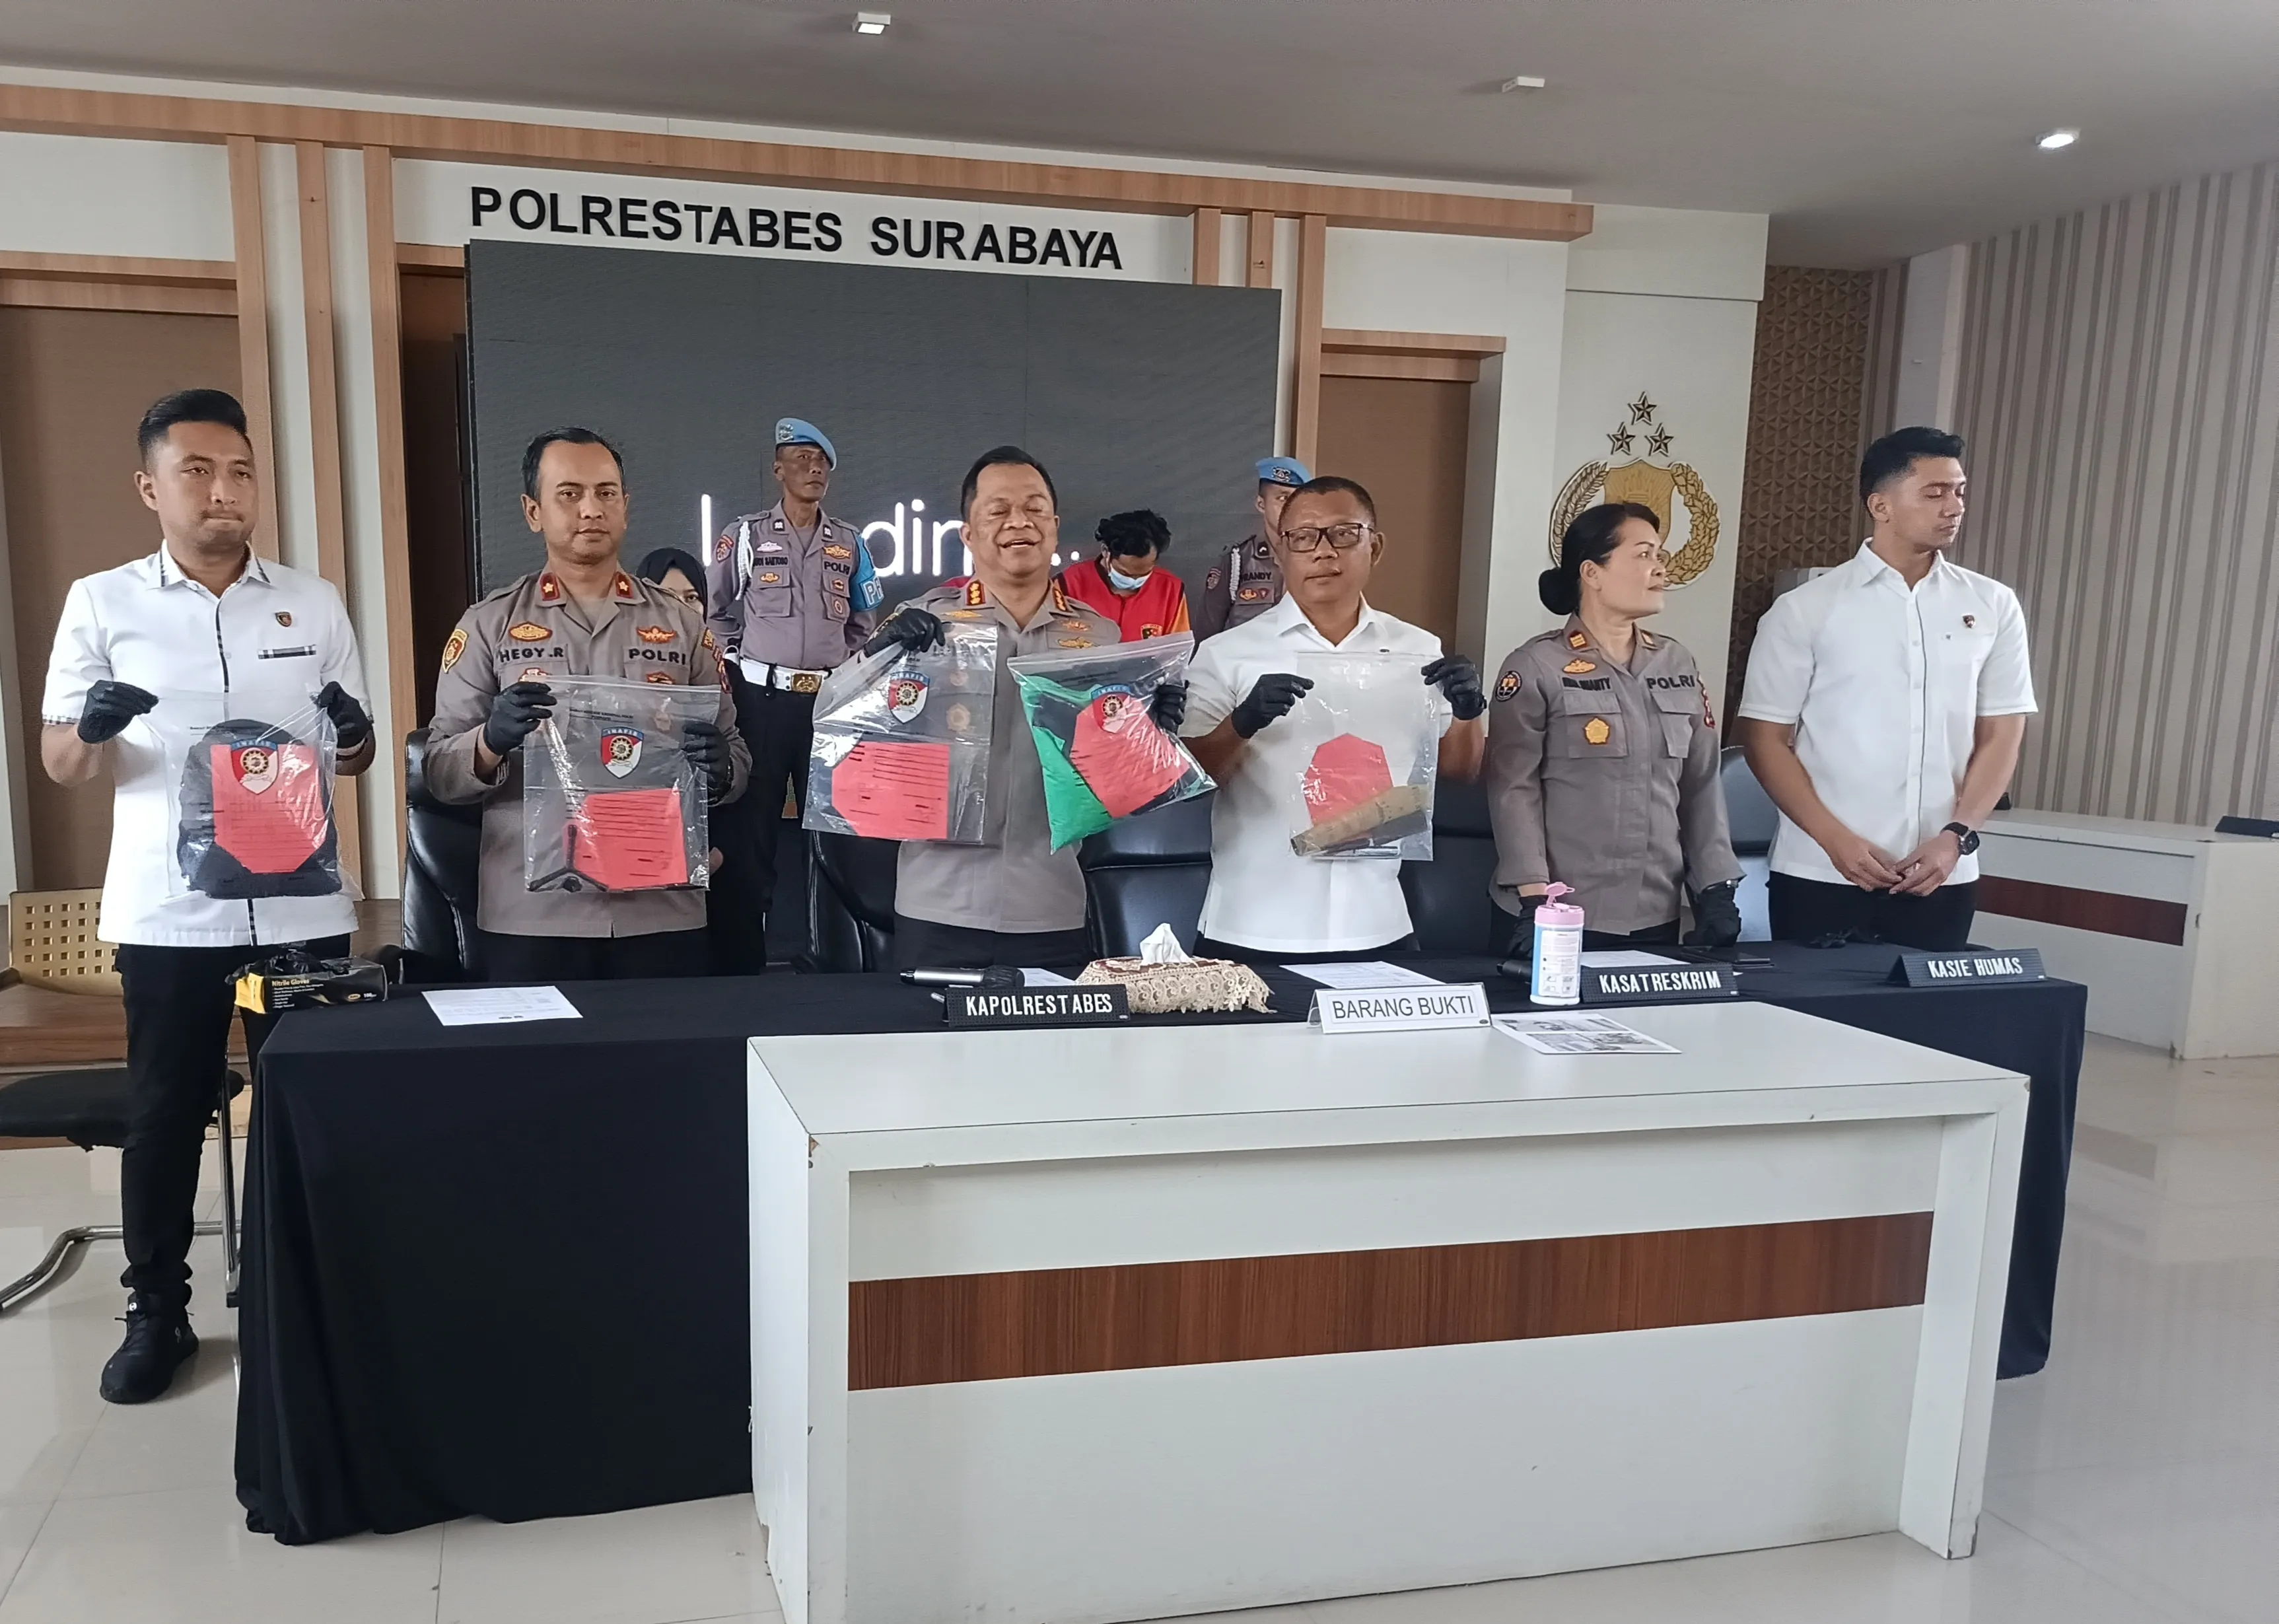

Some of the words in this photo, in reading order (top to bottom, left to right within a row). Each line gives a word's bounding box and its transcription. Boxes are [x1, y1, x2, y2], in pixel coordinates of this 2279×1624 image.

[470, 186, 842, 252] POLRESTABES
[870, 216, 1123, 271] SURABAYA
[824, 561, 850, 575] POLRI
[629, 648, 686, 666] POLRI
[1646, 674, 1695, 689] POLRI
[1928, 959, 1972, 978] KASIE
[1974, 957, 2023, 976] HUMAS
[1599, 970, 1722, 993] KASATRESKRIM
[966, 993, 1113, 1016] KAPOLRESTABES
[1332, 998, 1413, 1018] BARANG
[1417, 995, 1474, 1015] BUKTI
